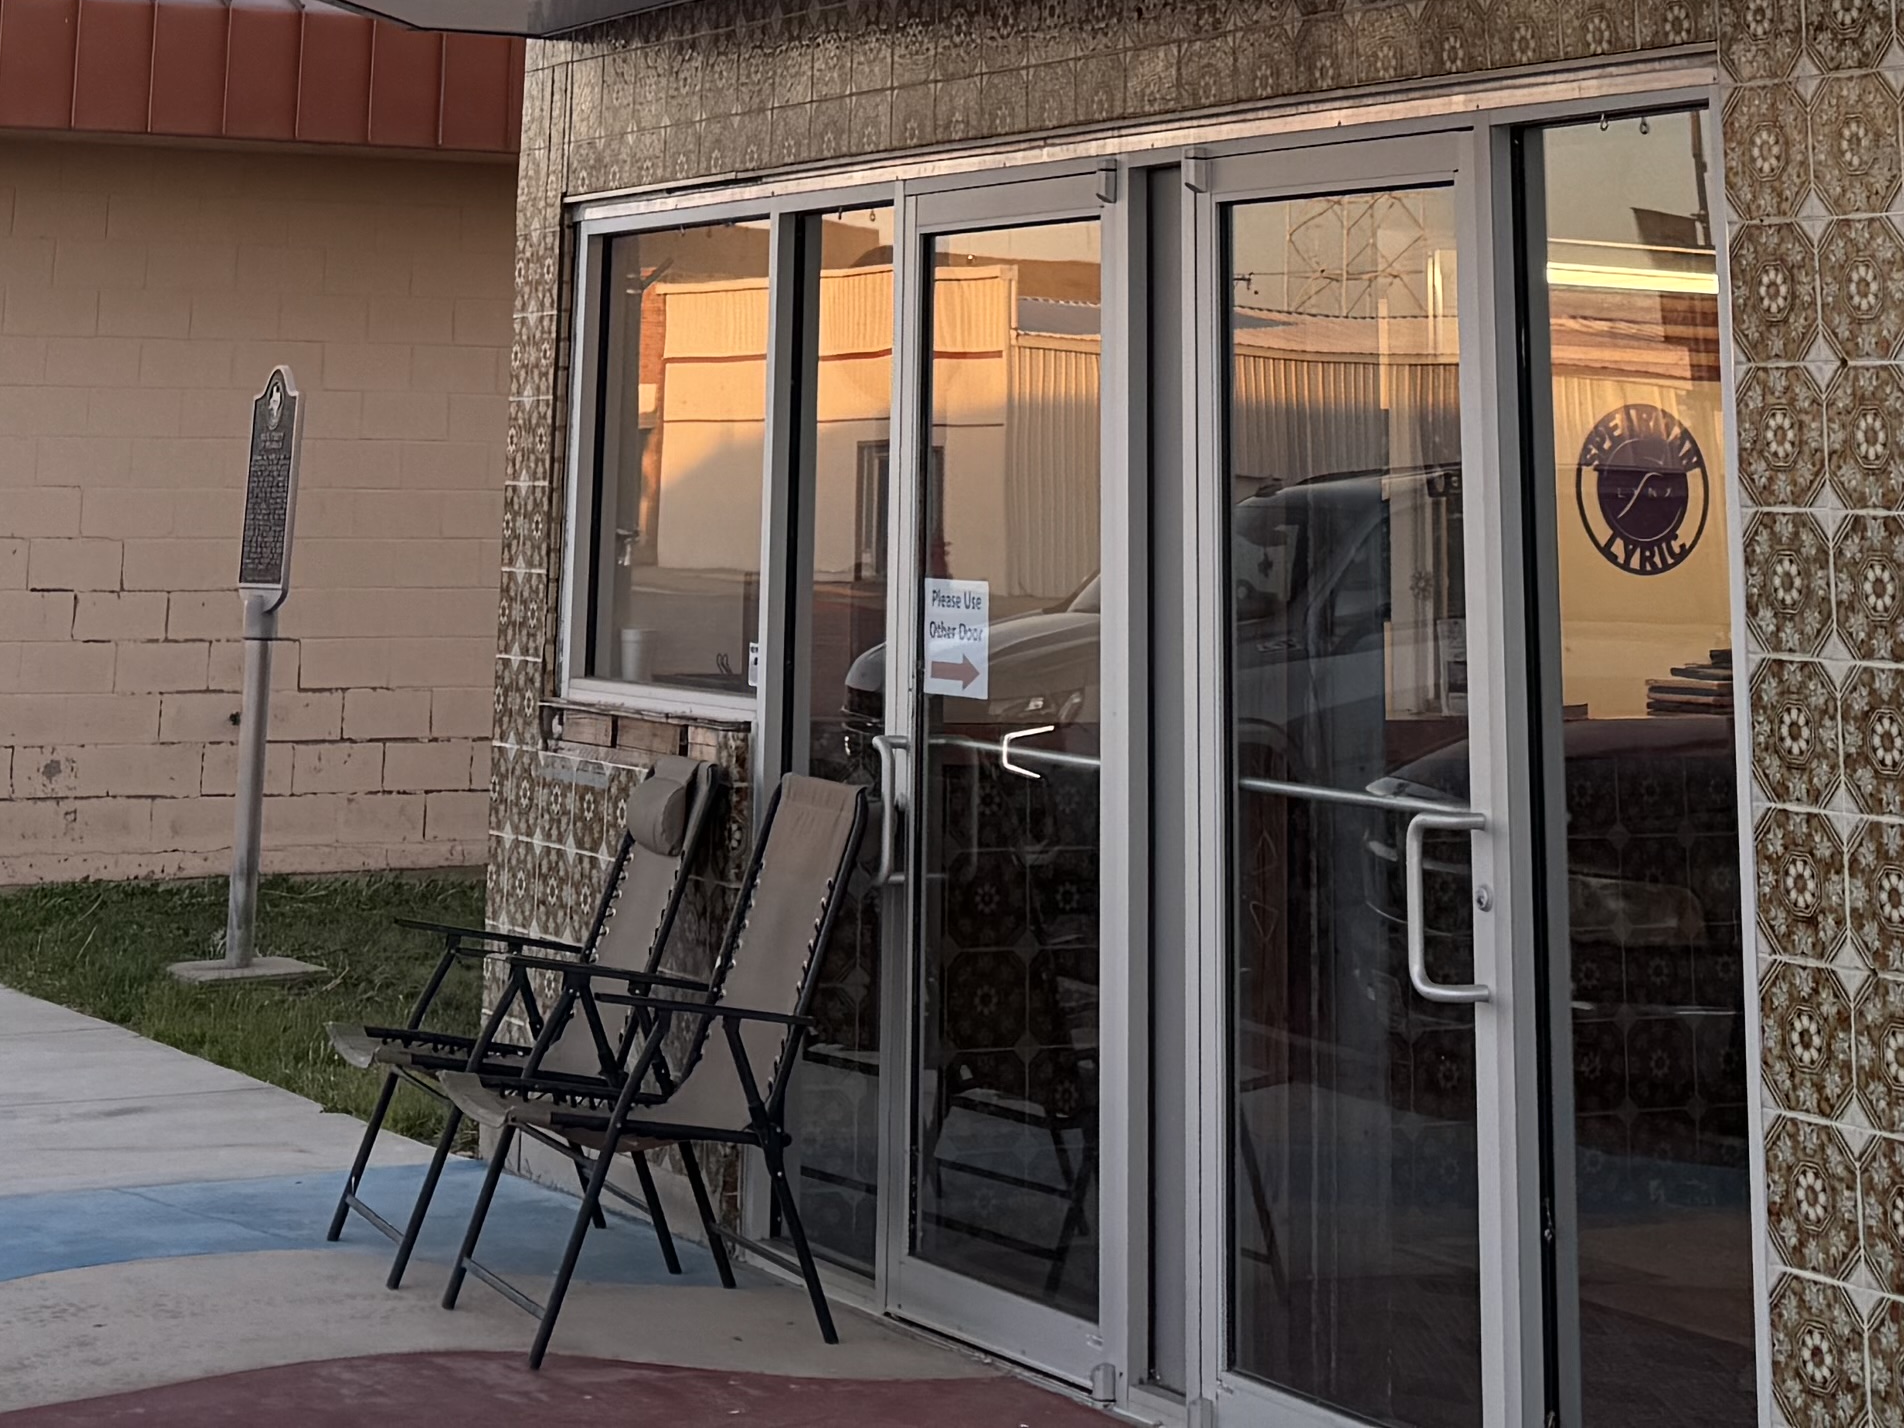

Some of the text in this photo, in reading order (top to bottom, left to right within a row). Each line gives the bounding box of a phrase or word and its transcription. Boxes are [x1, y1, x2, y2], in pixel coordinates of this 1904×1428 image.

[1602, 530, 1688, 573] LYRIC
[932, 589, 982, 610] Please Use
[929, 620, 983, 641] Other Door
